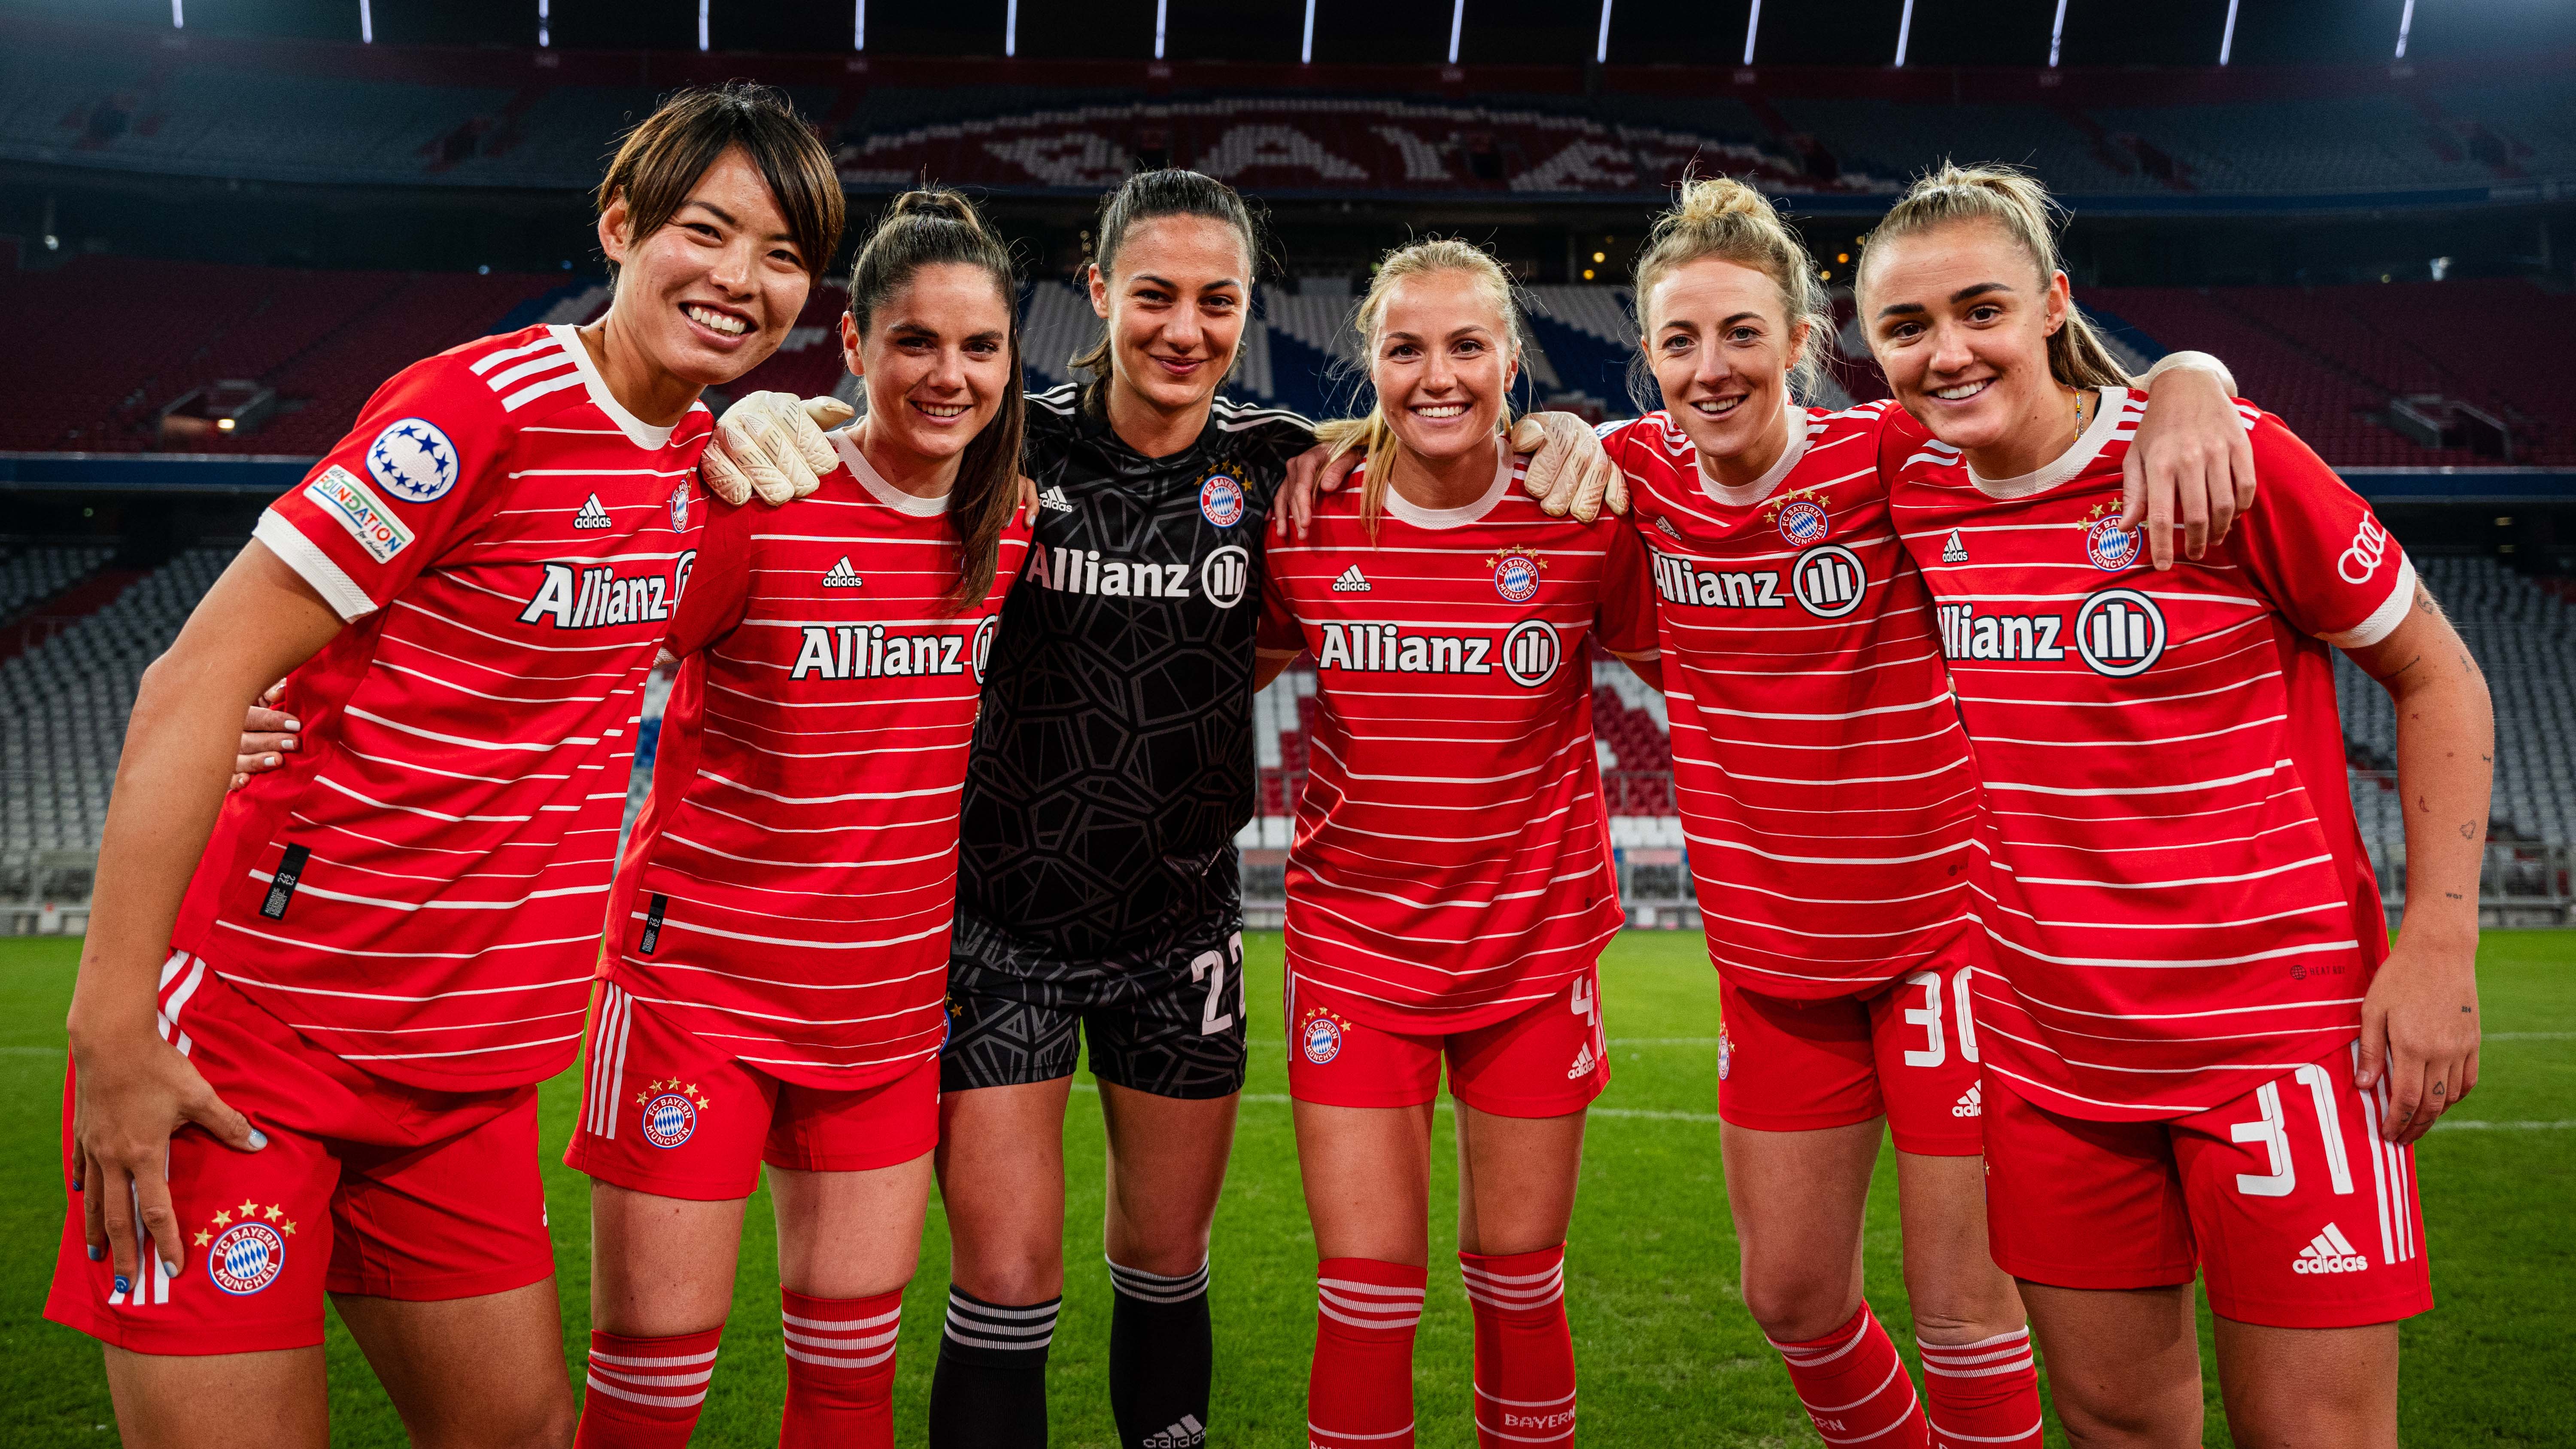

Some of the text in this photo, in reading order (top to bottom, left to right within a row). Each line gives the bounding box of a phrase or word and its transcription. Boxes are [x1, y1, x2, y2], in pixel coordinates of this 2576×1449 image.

[1204, 478, 1241, 500] FC BAYERN
[316, 475, 401, 553] FOUNDATION
[574, 515, 612, 529] adidas
[1203, 505, 1241, 525] MÜNCHEN
[1782, 505, 1821, 526] FC BAYERN
[355, 530, 367, 539] for
[1656, 522, 1682, 541] adidas
[2091, 527, 2103, 540] FC
[366, 540, 386, 559] children
[1942, 550, 1968, 562] adidas
[2091, 548, 2136, 568] MÜNCHEN
[1025, 541, 1190, 597] Allianz
[1498, 559, 1536, 577] FC BAYERN
[823, 575, 863, 587] adidas
[1332, 581, 1372, 592] adidas
[1652, 549, 1786, 609] Allianz
[516, 562, 668, 629] Allianz
[1498, 583, 1536, 600] MÜNCHEN
[790, 625, 964, 680] Allianz
[1319, 623, 1492, 674] Allianz
[277, 872, 289, 884] 22
[265, 887, 279, 913] AUTHENTIC
[270, 892, 283, 915] LICENSED
[276, 896, 288, 917] PRODUCT
[1571, 975, 1595, 1027] 4
[1306, 1022, 1338, 1039] FC BAYERN
[1306, 1045, 1337, 1062] MÜNCHEN
[1567, 1059, 1595, 1080] adidas
[648, 1097, 693, 1119] FC BAYERN
[646, 1124, 690, 1145] MÜNCHEN
[2230, 1063, 2354, 1197] 31
[216, 1227, 279, 1257] FC BAYERN
[2292, 1253, 2368, 1274] adidas
[215, 1262, 278, 1291] MÜNCHEN
[1504, 1404, 1576, 1429] BAYERN
